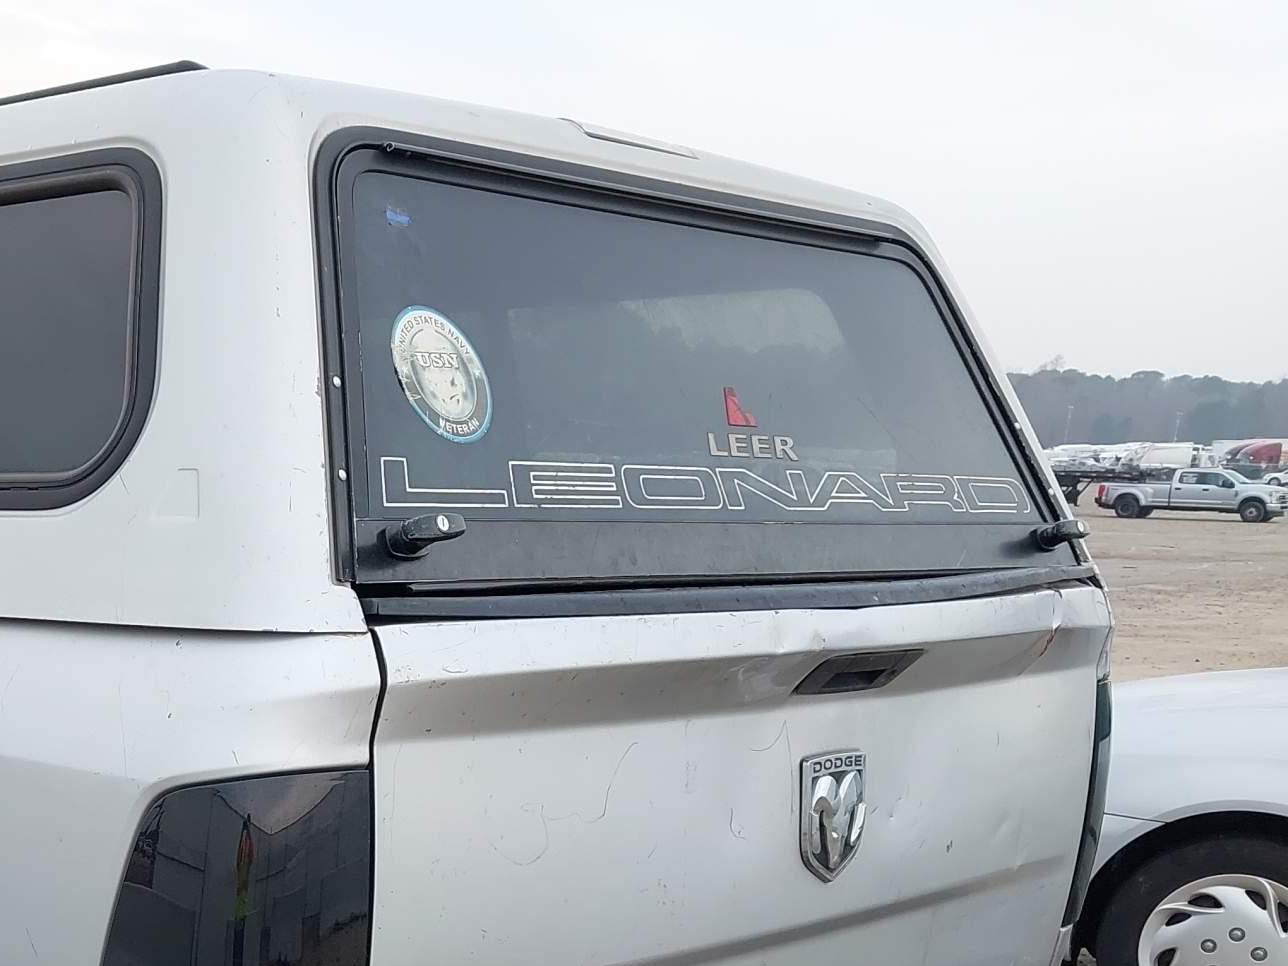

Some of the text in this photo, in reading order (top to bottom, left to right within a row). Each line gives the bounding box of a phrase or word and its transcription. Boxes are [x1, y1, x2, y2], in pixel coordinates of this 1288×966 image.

[397, 315, 471, 355] UNITED STATES NAVY
[414, 352, 459, 369] USN
[439, 417, 480, 434] VETERAN
[707, 431, 799, 461] LEER
[381, 456, 1030, 513] LEONARD
[813, 754, 863, 774] DODGE
